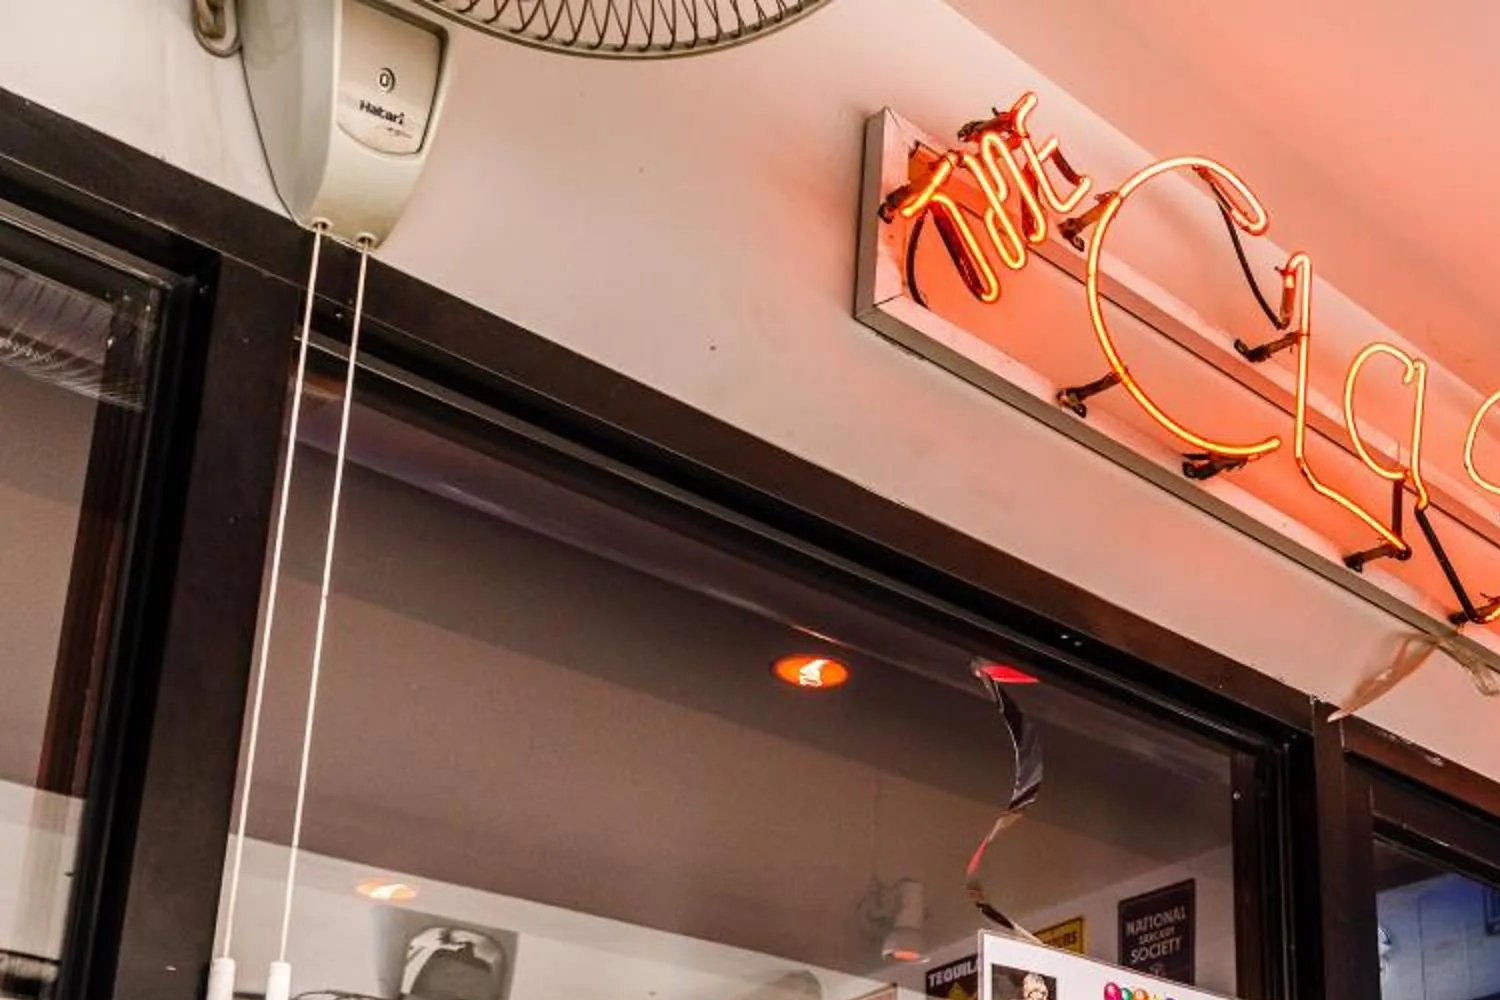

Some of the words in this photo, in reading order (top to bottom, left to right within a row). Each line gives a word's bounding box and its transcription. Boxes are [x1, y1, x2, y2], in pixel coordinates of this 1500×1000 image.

[359, 99, 405, 125] Hatari
[1126, 905, 1187, 937] NATIONAL
[1131, 937, 1182, 964] SOCIETY
